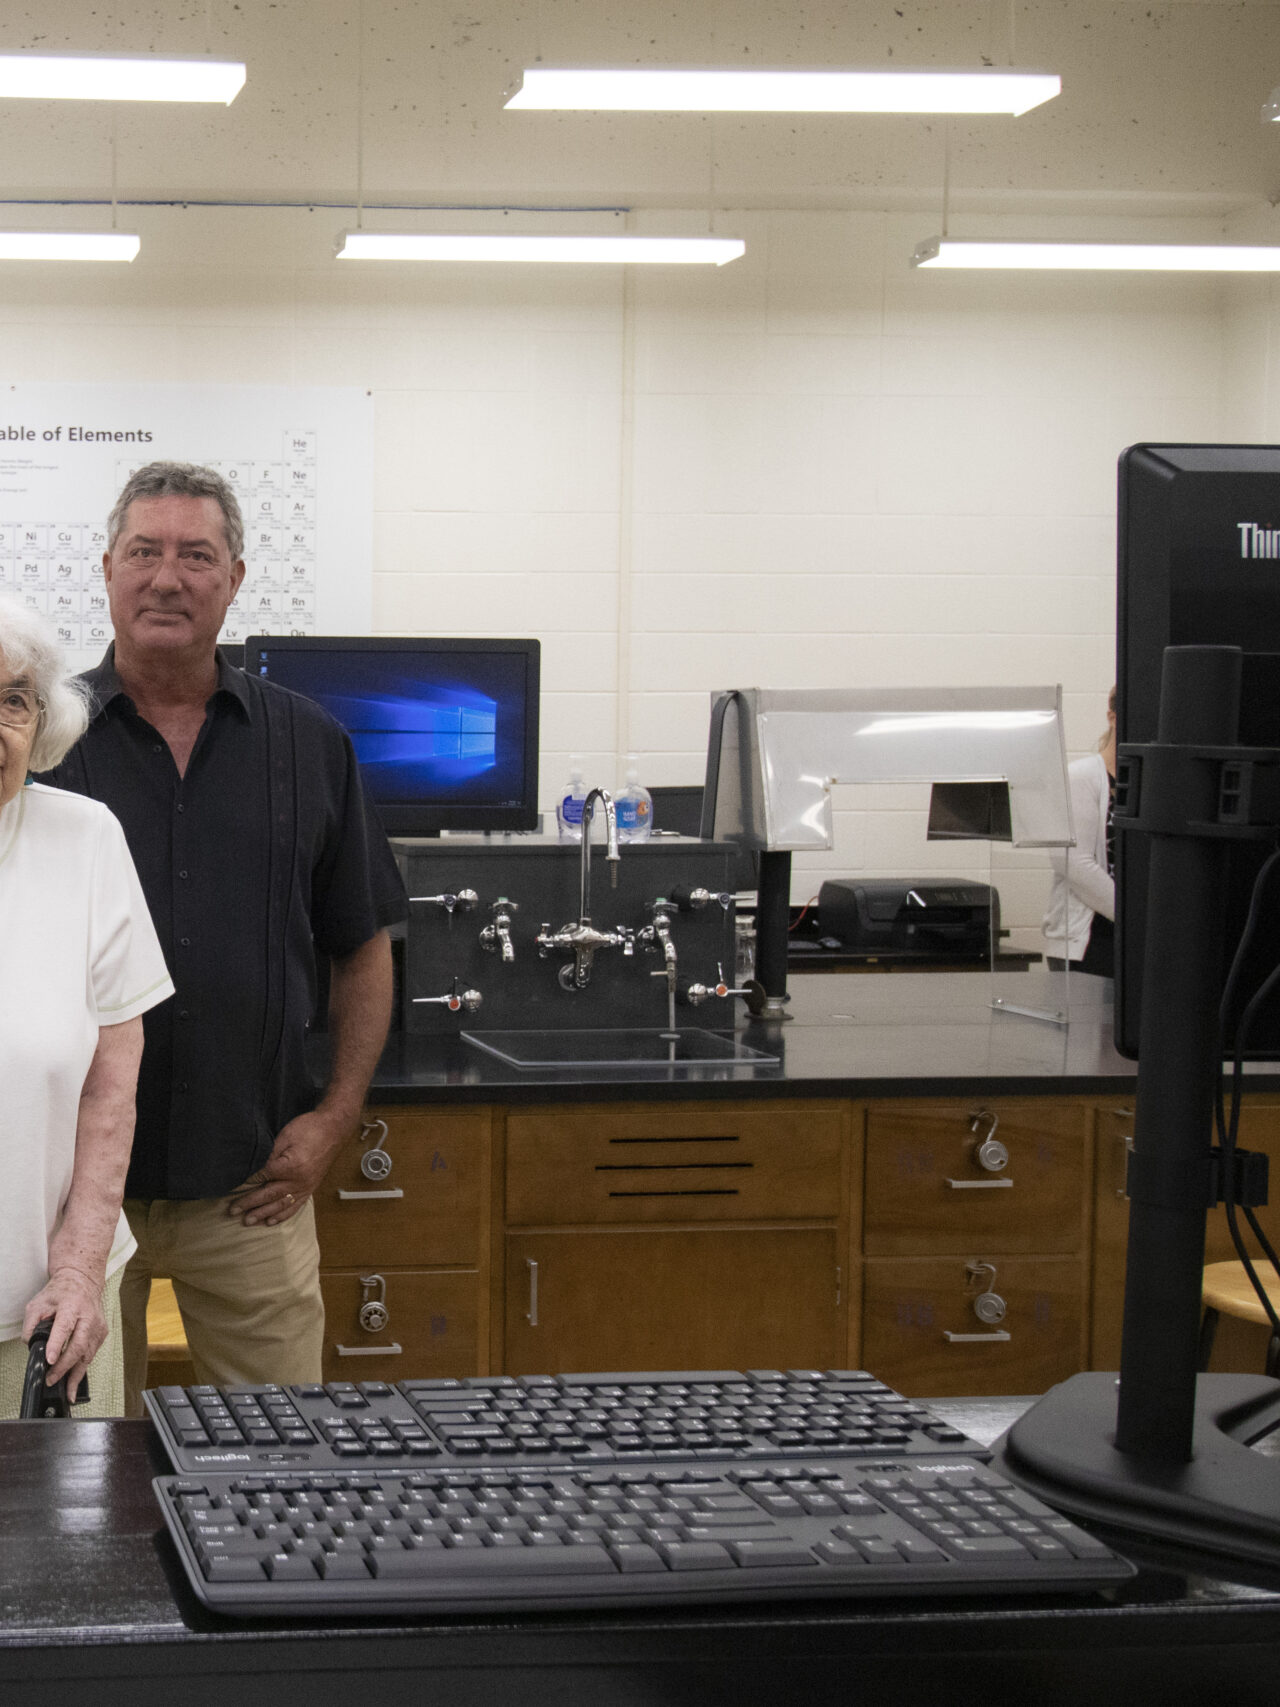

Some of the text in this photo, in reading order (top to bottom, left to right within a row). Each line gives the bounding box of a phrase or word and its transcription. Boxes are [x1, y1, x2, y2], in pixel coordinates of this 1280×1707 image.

[43, 426, 62, 441] of
[69, 427, 152, 442] Elements
[293, 440, 307, 448] He
[229, 470, 237, 479] O
[264, 470, 269, 478] F
[261, 502, 271, 511] Cl
[294, 503, 305, 512] Ar
[58, 532, 71, 541] Cu
[91, 533, 105, 542] Zn
[261, 534, 271, 543] Br
[25, 564, 38, 572] Pd
[58, 565, 71, 577] Ag
[57, 596, 71, 605] Au
[91, 596, 105, 608] Hg
[260, 597, 270, 606] At
[292, 597, 305, 606] Rn
[58, 628, 71, 640] Rg
[91, 628, 104, 637] Cn
[917, 1465, 976, 1473] logitech
